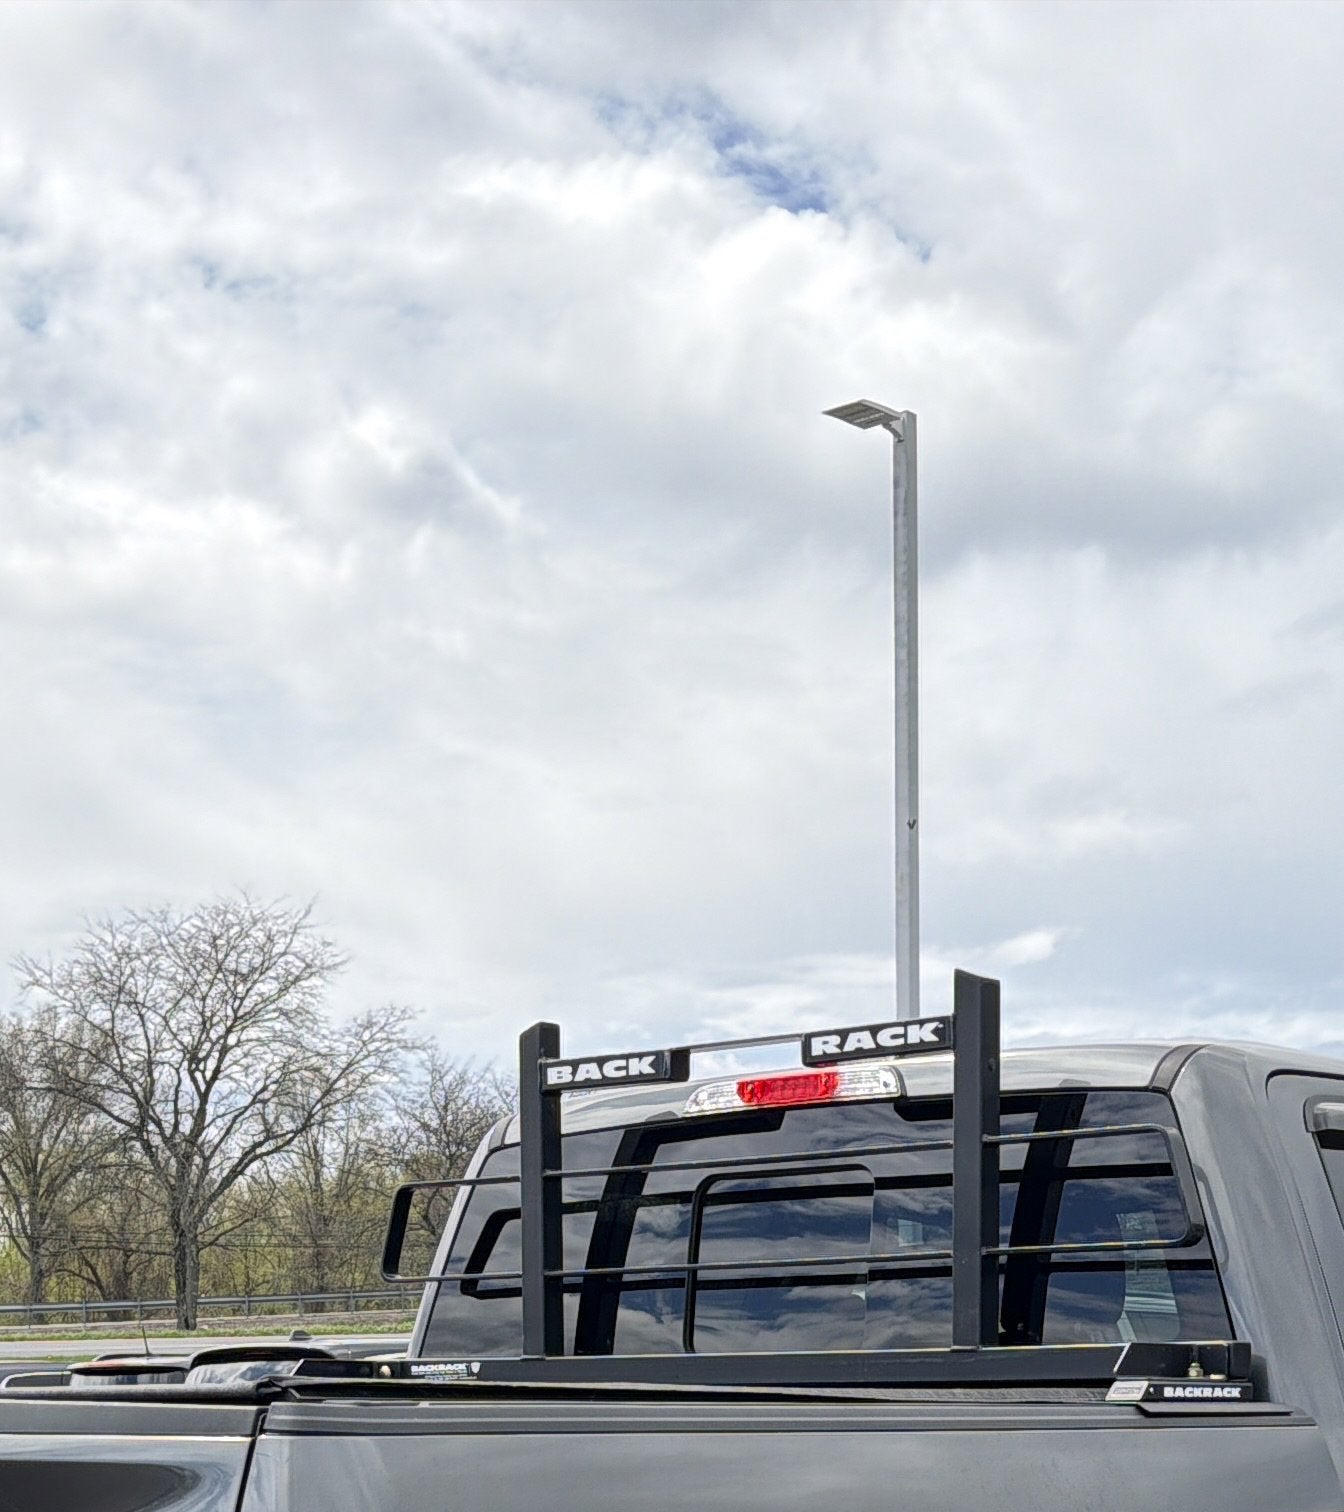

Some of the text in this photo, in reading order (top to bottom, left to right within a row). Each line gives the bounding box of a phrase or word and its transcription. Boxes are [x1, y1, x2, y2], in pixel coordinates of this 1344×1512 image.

[546, 1021, 940, 1085] BACK RACK
[1163, 1386, 1241, 1398] BACKRACK
